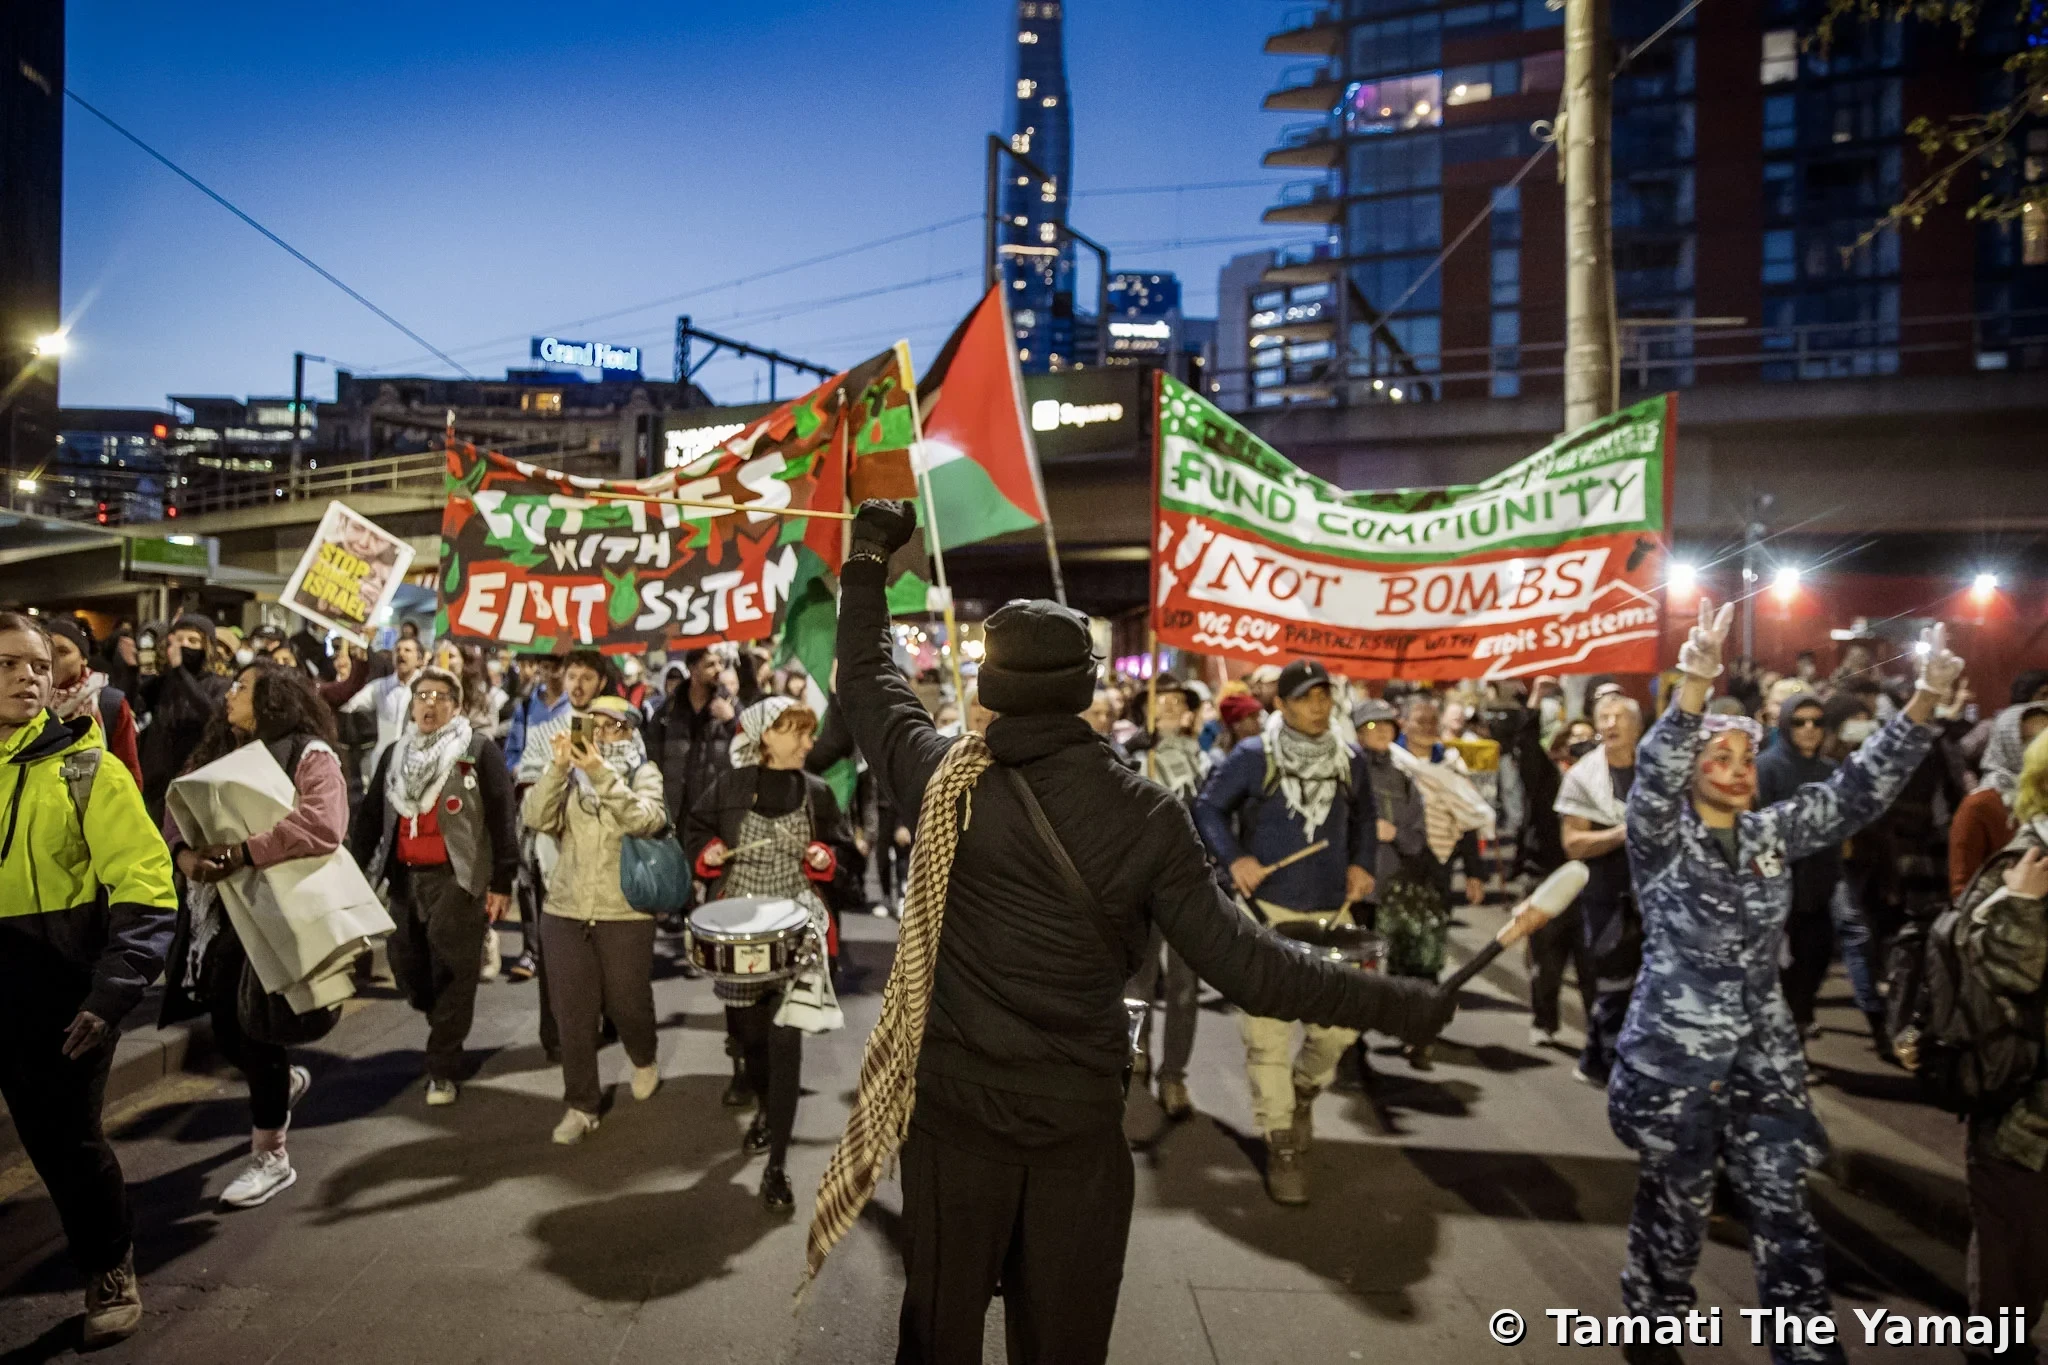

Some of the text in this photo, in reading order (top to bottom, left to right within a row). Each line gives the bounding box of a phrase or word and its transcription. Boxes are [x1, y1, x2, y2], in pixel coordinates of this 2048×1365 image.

[541, 338, 638, 371] Grand Hotel
[1171, 451, 1639, 545] FUND COMMUNITY
[319, 543, 370, 578] STOP
[550, 531, 671, 572] WITH
[302, 571, 366, 622] ISRAEL
[458, 572, 606, 644] ELBIT
[1207, 552, 1587, 616] NOT BOMBS
[1198, 611, 1232, 636] VIC
[1235, 615, 1280, 641] GOV
[1425, 632, 1477, 651] WITH
[1472, 627, 1537, 659] Elbit
[1543, 606, 1657, 648] Systems
